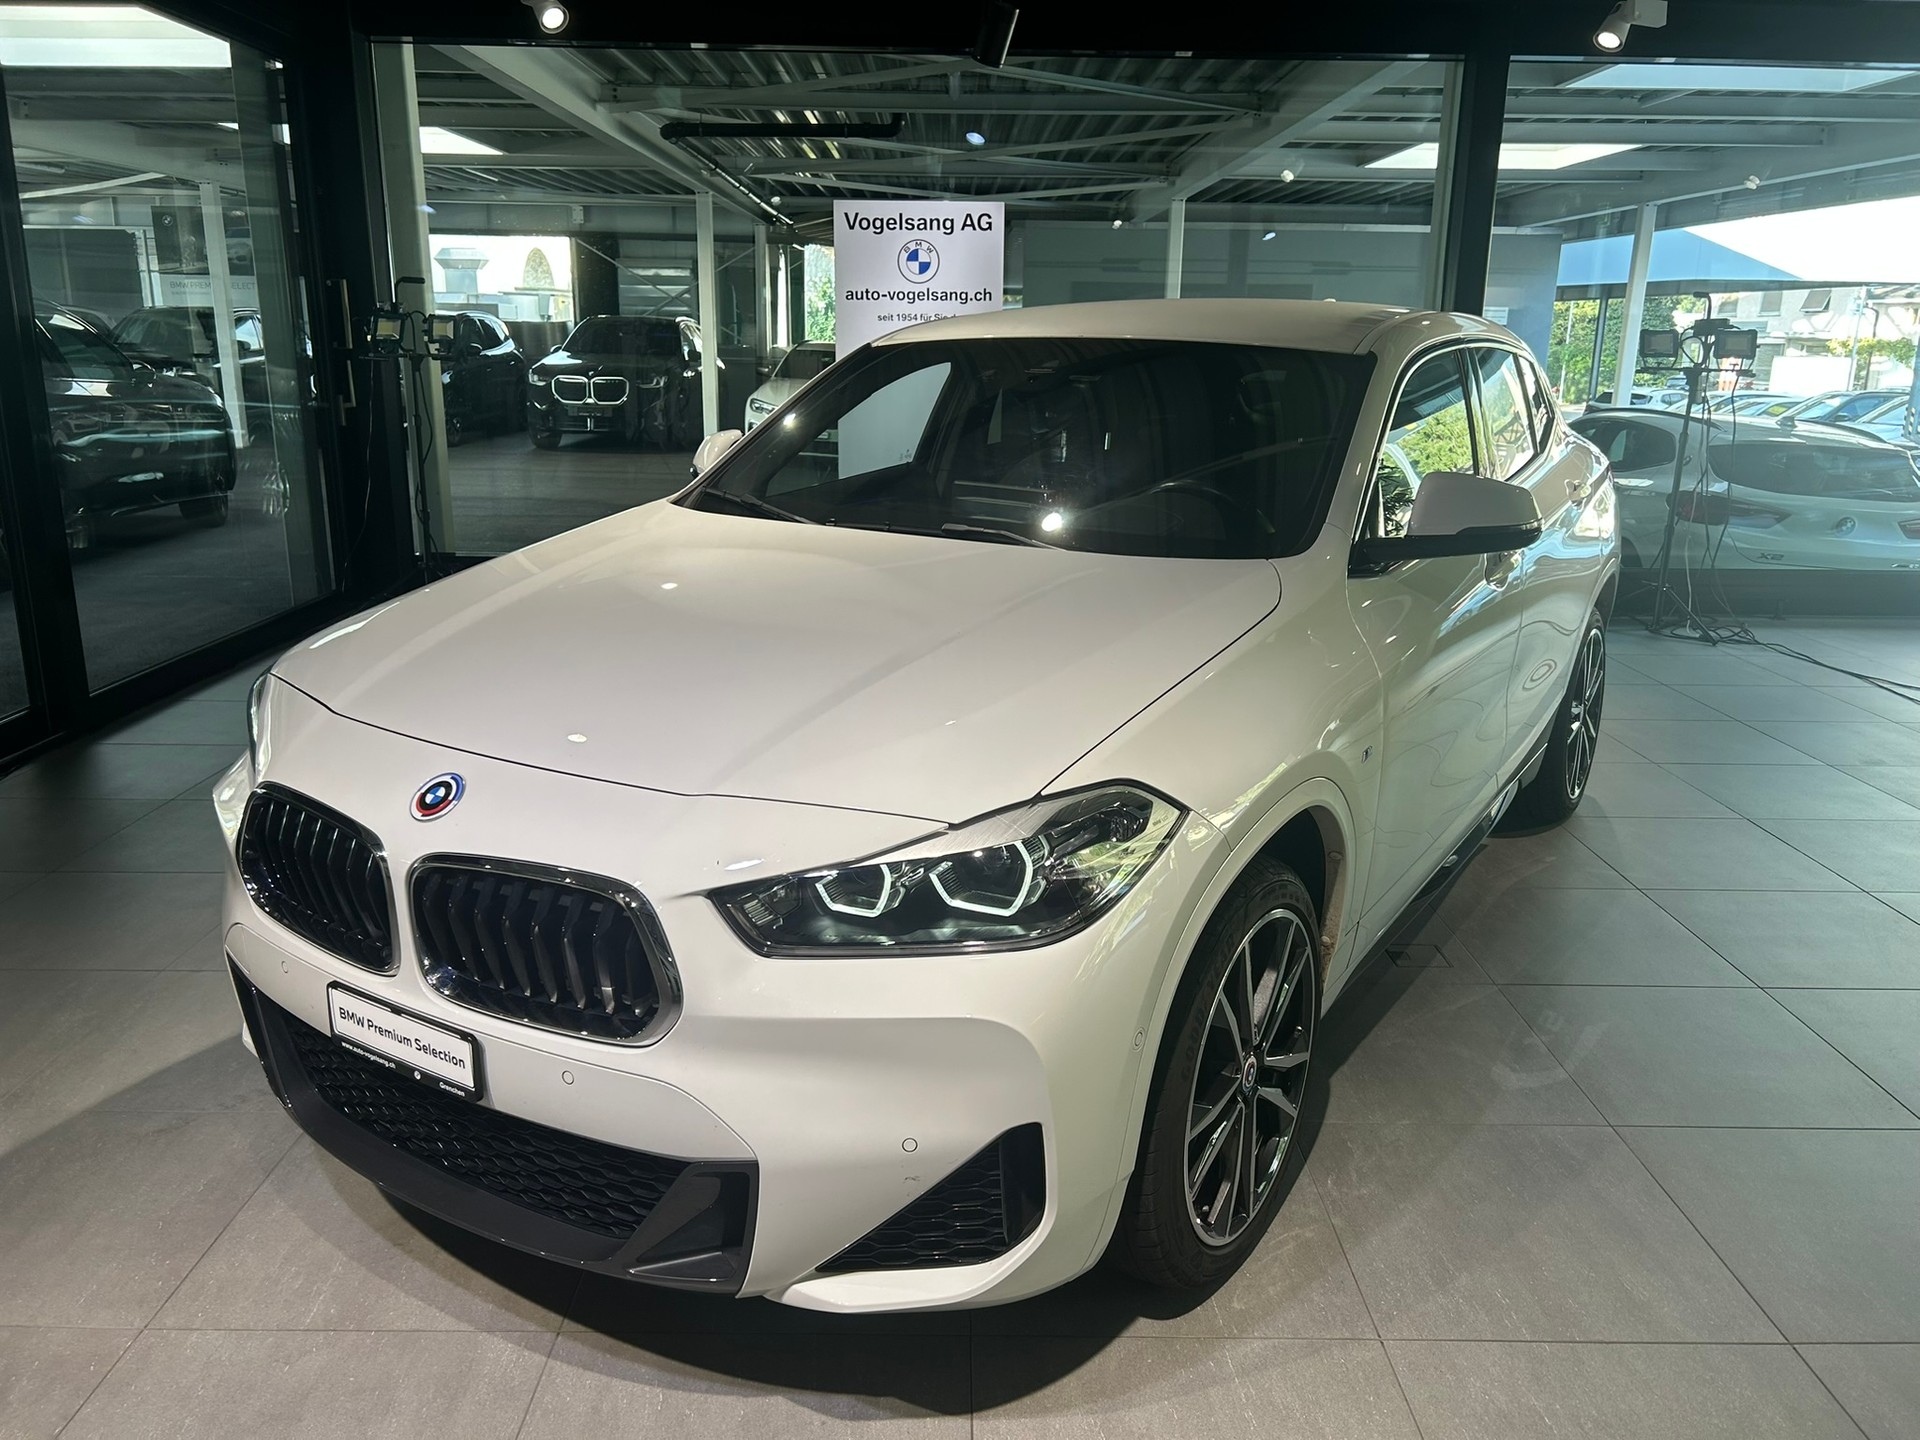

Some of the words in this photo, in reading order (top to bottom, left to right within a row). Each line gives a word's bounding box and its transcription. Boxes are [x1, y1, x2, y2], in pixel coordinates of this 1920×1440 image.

[844, 212, 955, 235] Vogelsang
[961, 212, 993, 232] AG
[903, 241, 934, 254] BMW
[169, 281, 188, 289] BMW
[190, 281, 211, 289] PREM
[845, 288, 993, 305] auto-vogelsang.ch
[877, 313, 894, 322] seit
[896, 313, 918, 322] 1954
[919, 313, 932, 322] für
[1757, 552, 1785, 561] X2
[339, 1006, 365, 1028] BMW
[366, 1018, 413, 1048] Premium
[415, 1038, 466, 1070] Selection
[341, 1041, 397, 1069] www.auto-vogelsang.ch
[438, 1081, 466, 1097] Grenchen
